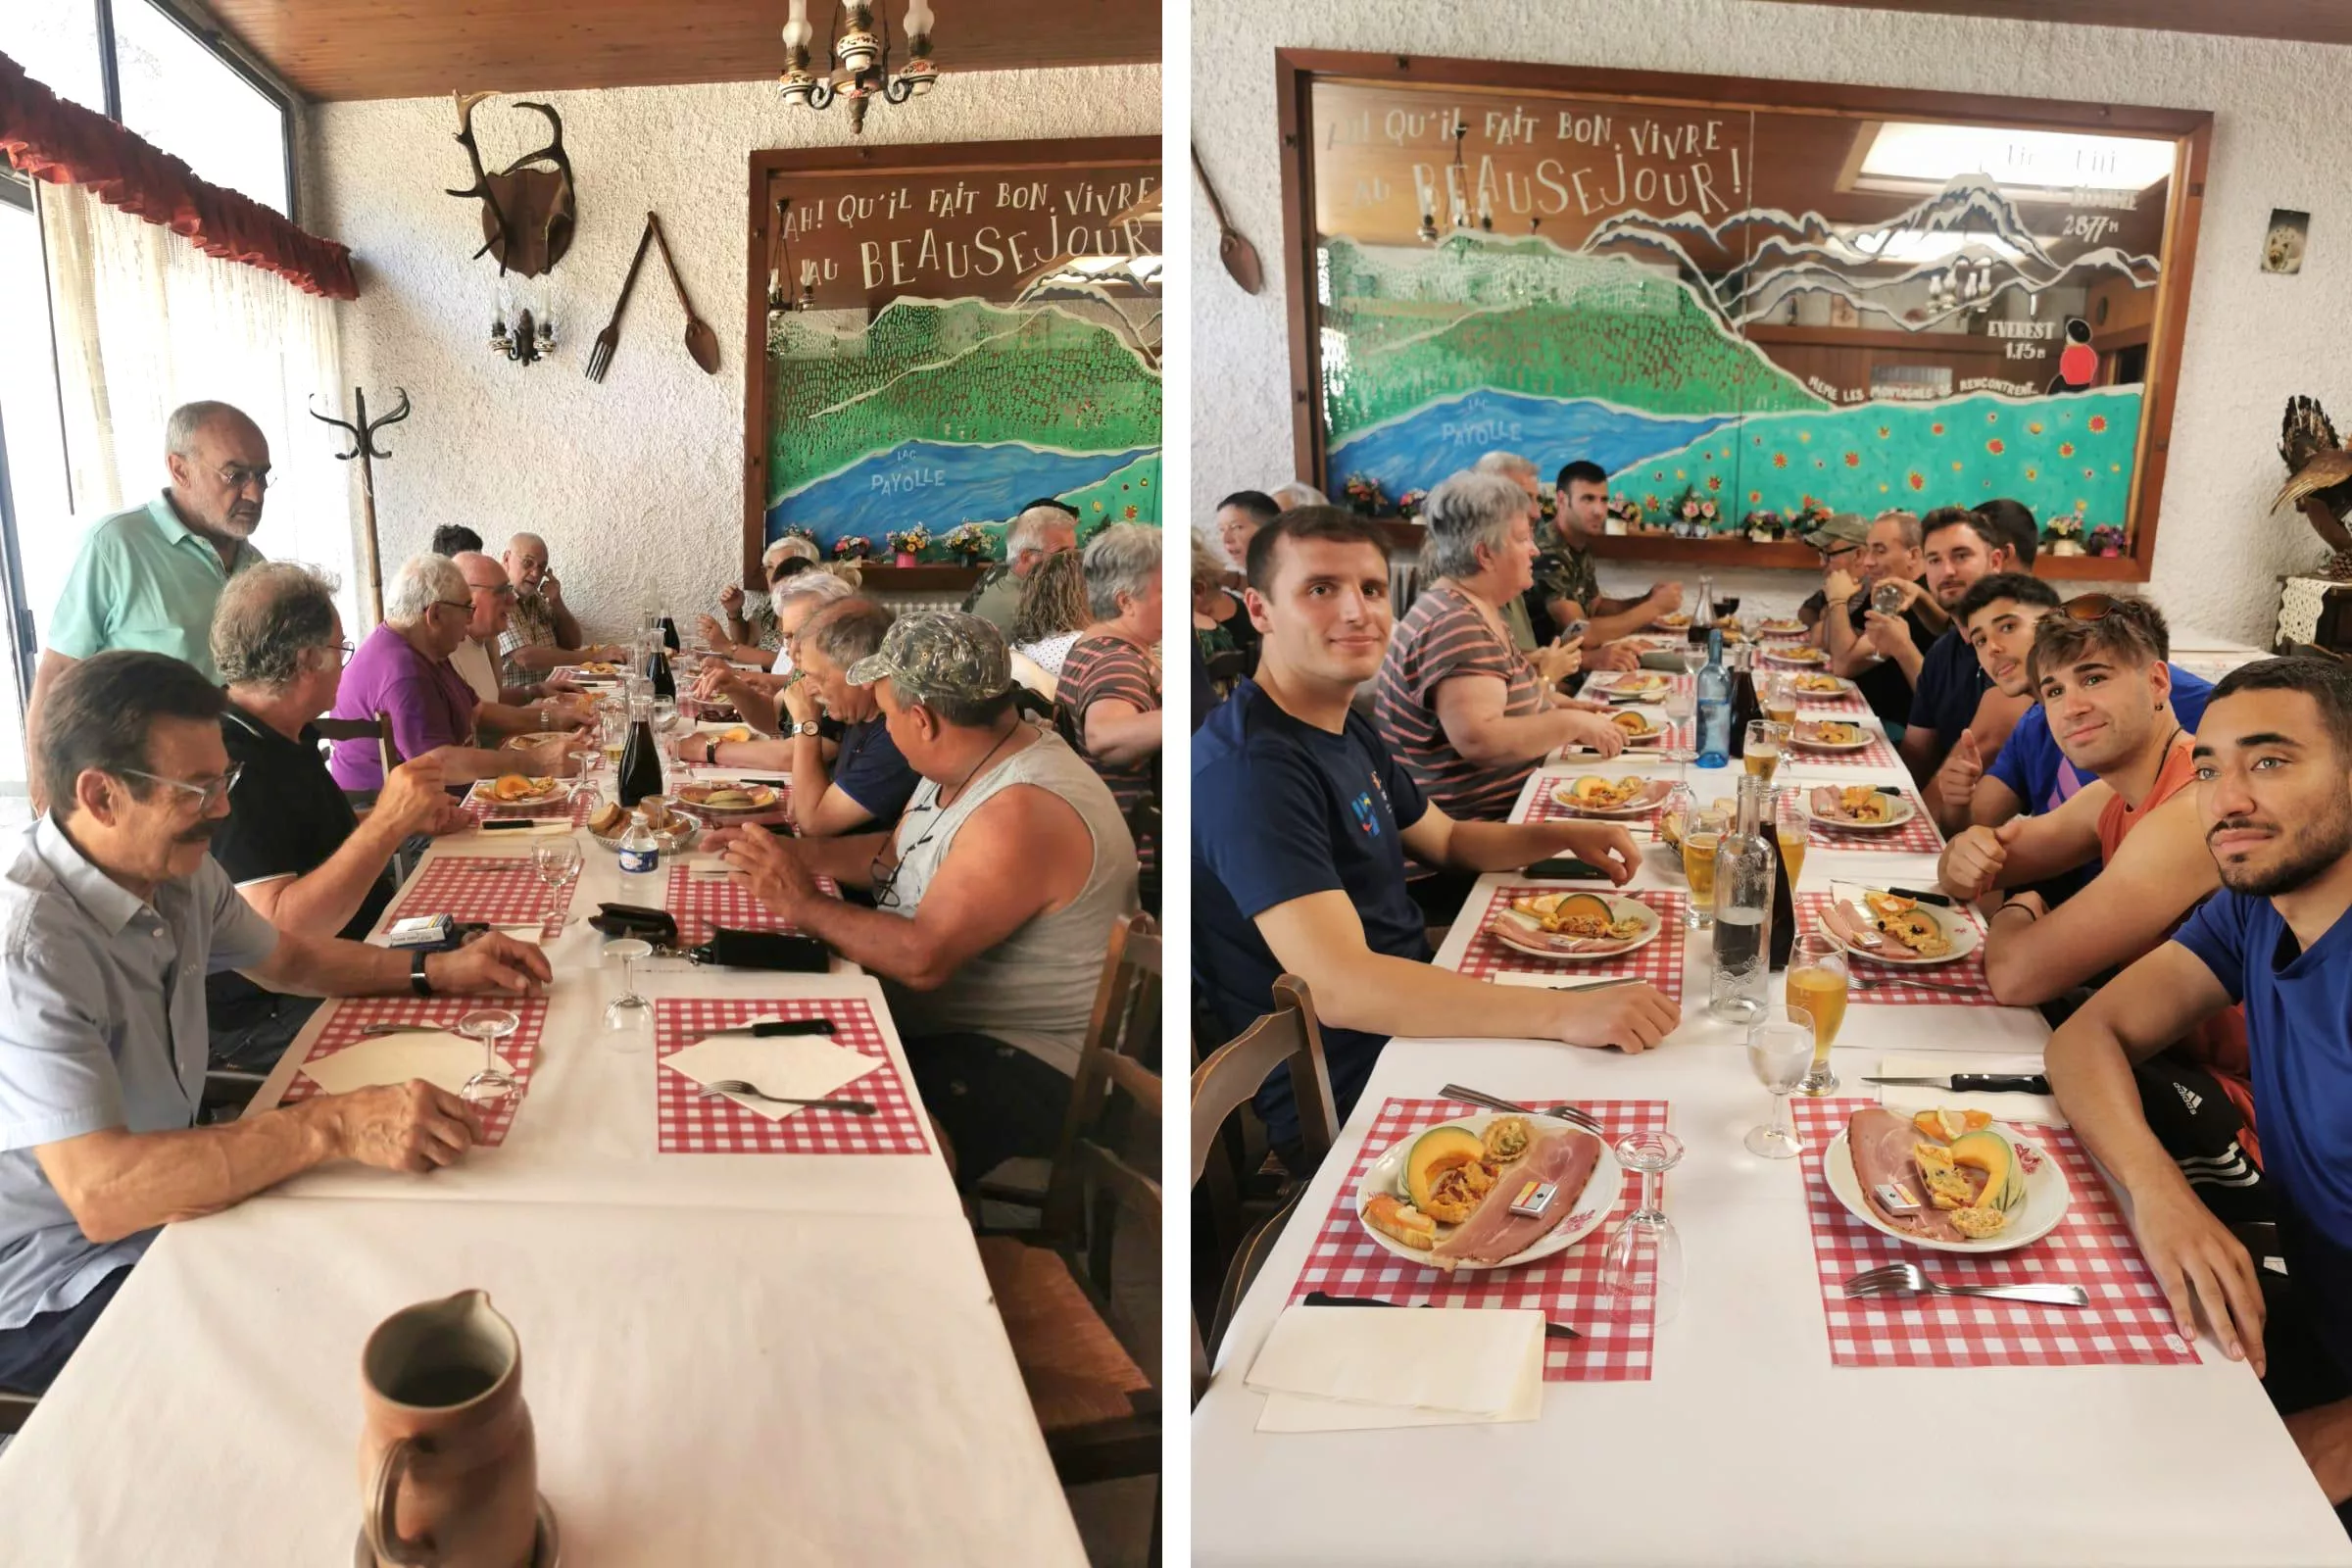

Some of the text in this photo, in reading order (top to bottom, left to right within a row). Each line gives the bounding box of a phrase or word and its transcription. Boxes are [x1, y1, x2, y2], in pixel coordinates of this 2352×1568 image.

[1558, 112, 1611, 146] BON
[1353, 176, 1391, 208] AU
[783, 200, 824, 242] AH!
[997, 182, 1047, 212] BON
[1987, 320, 2056, 340] EVEREST
[1469, 398, 1490, 411] LAC
[1843, 388, 1864, 402] LES
[1442, 418, 1523, 448] PAYOLLE
[898, 449, 916, 462] LAC
[871, 467, 946, 498] PAYOLLE
[2173, 1082, 2197, 1115] adidas
